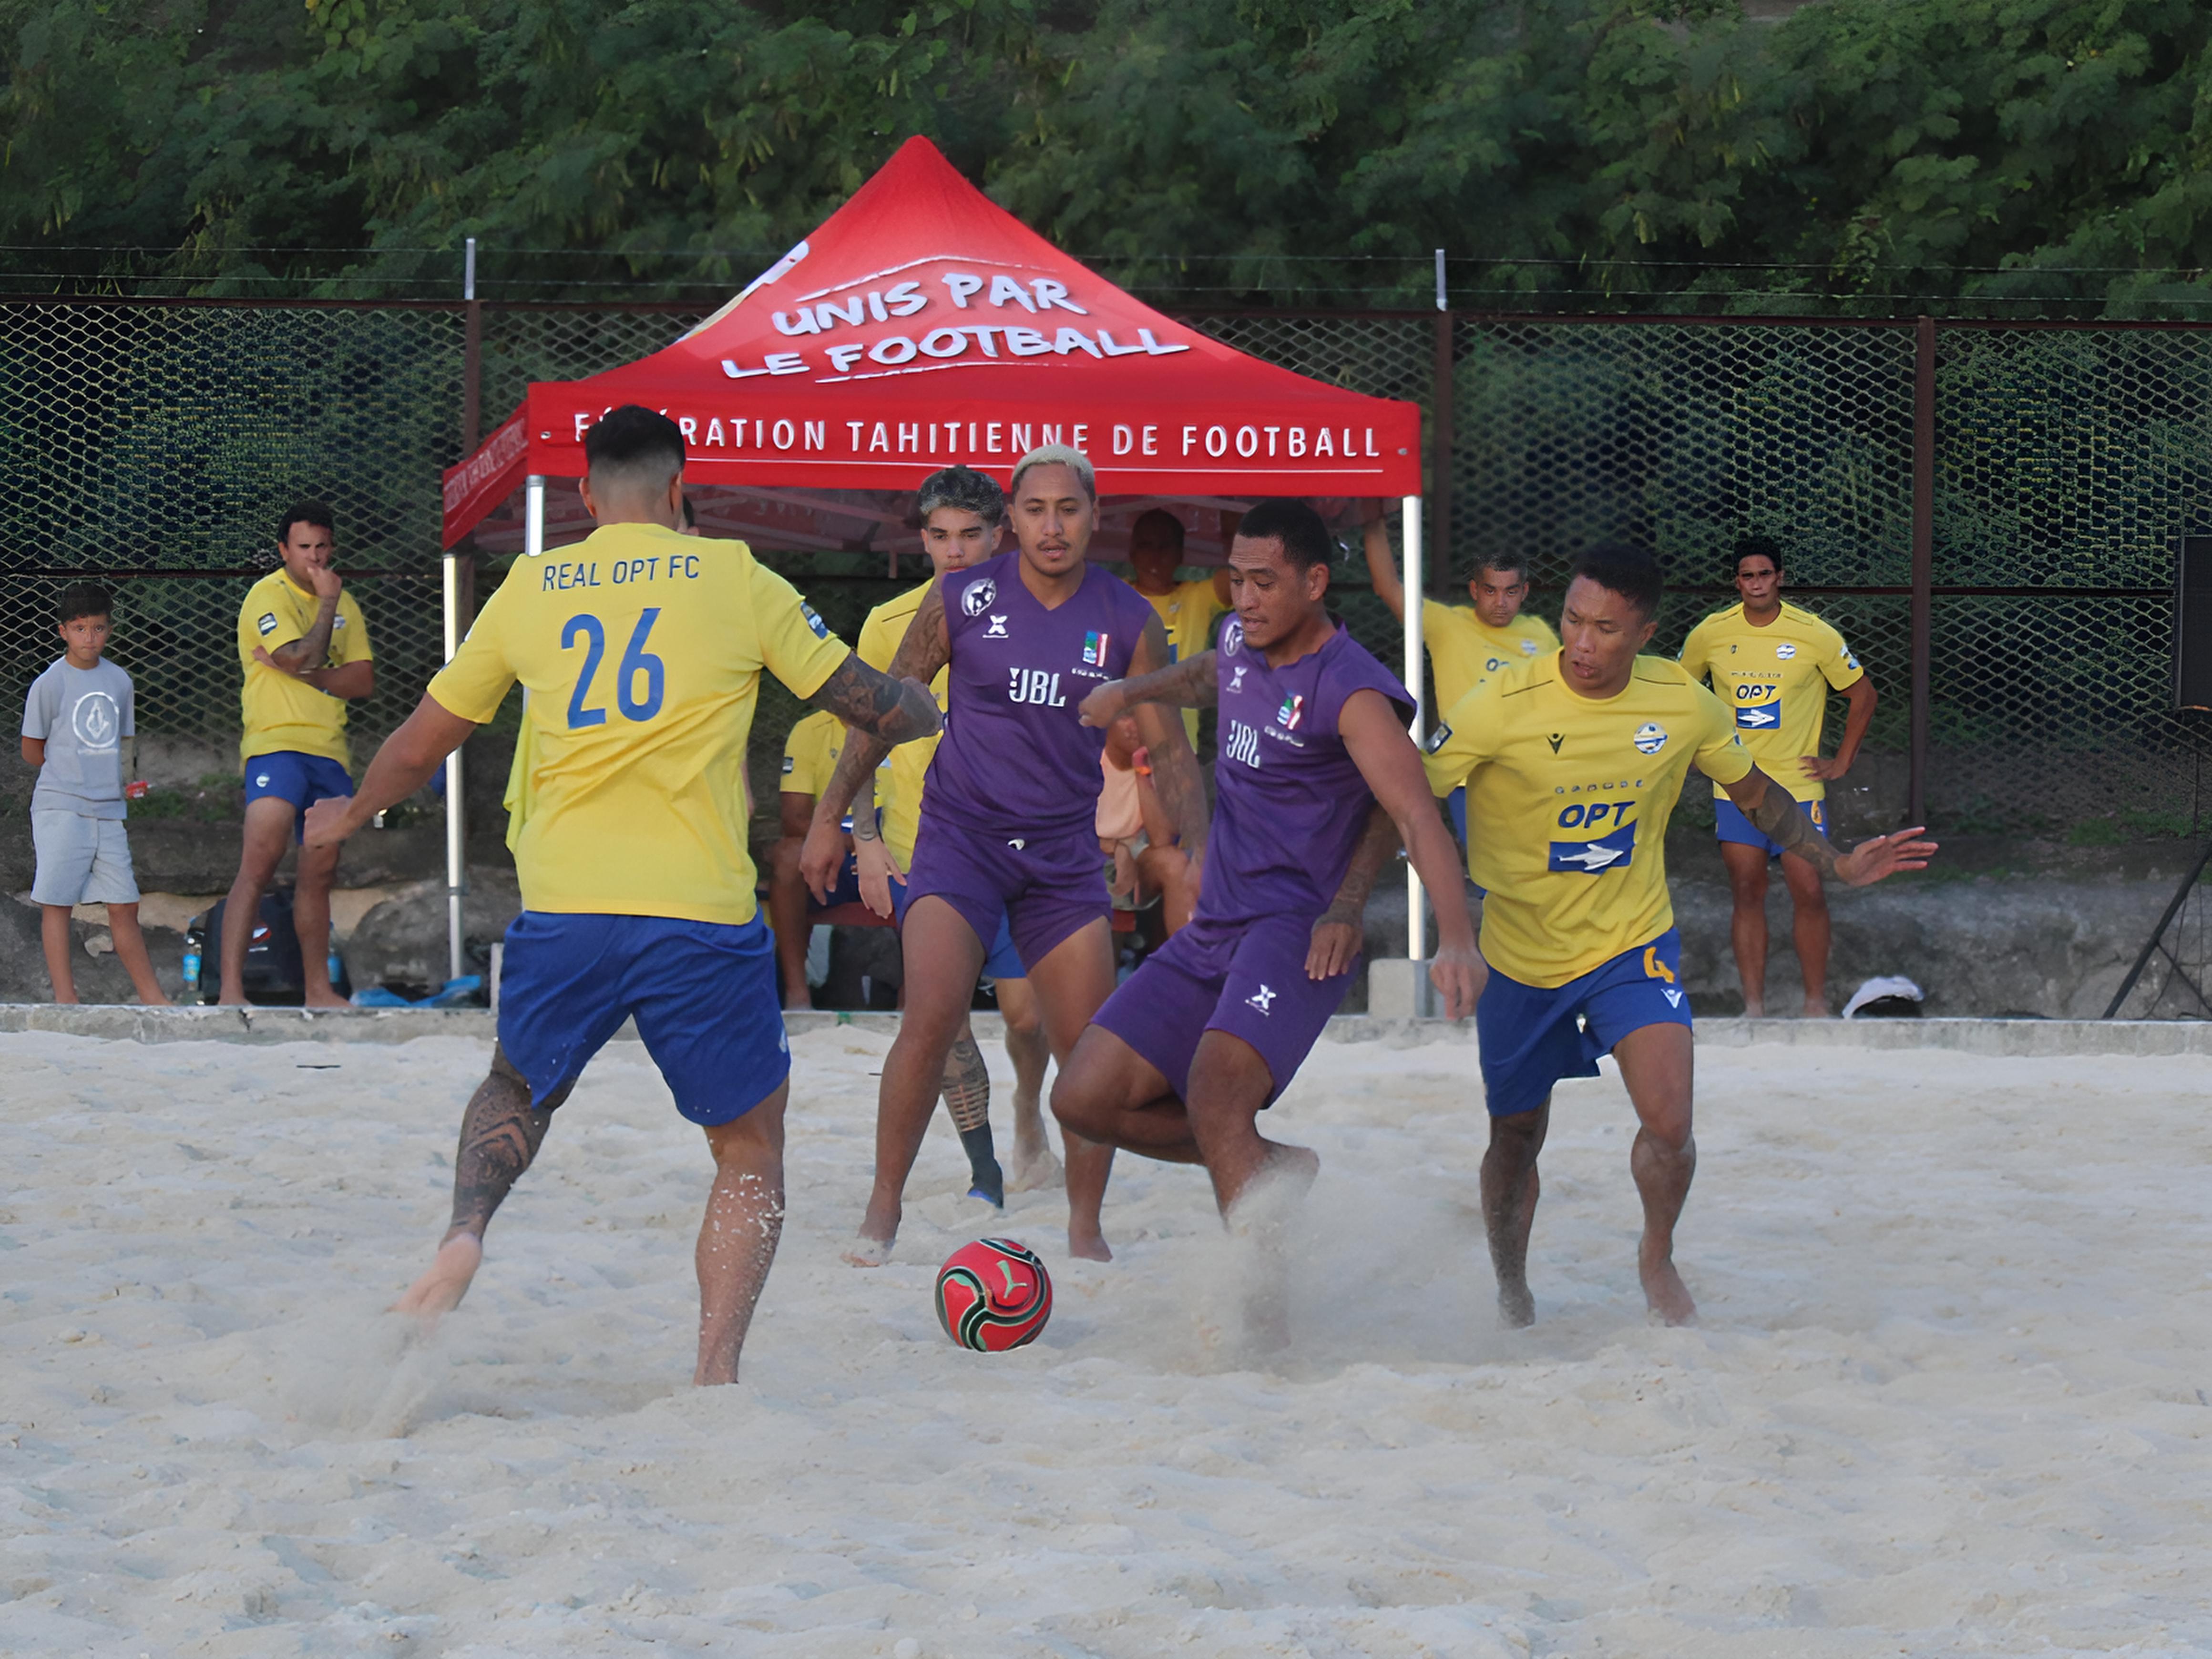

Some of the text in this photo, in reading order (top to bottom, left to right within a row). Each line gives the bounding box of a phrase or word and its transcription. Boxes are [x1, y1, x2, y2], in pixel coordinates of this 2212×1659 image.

[771, 272, 1088, 336] UNIS PAR
[721, 326, 1190, 378] LE FOOTBALL
[574, 407, 1380, 457] FRATION TAHITIENNE DE FOOTBALL
[543, 554, 699, 591] REAL OPT FC
[561, 607, 665, 729] 26
[1009, 667, 1066, 707] JBL
[1226, 719, 1260, 768] JBL
[1558, 801, 1635, 828] OPT
[1643, 947, 1675, 983] 4
